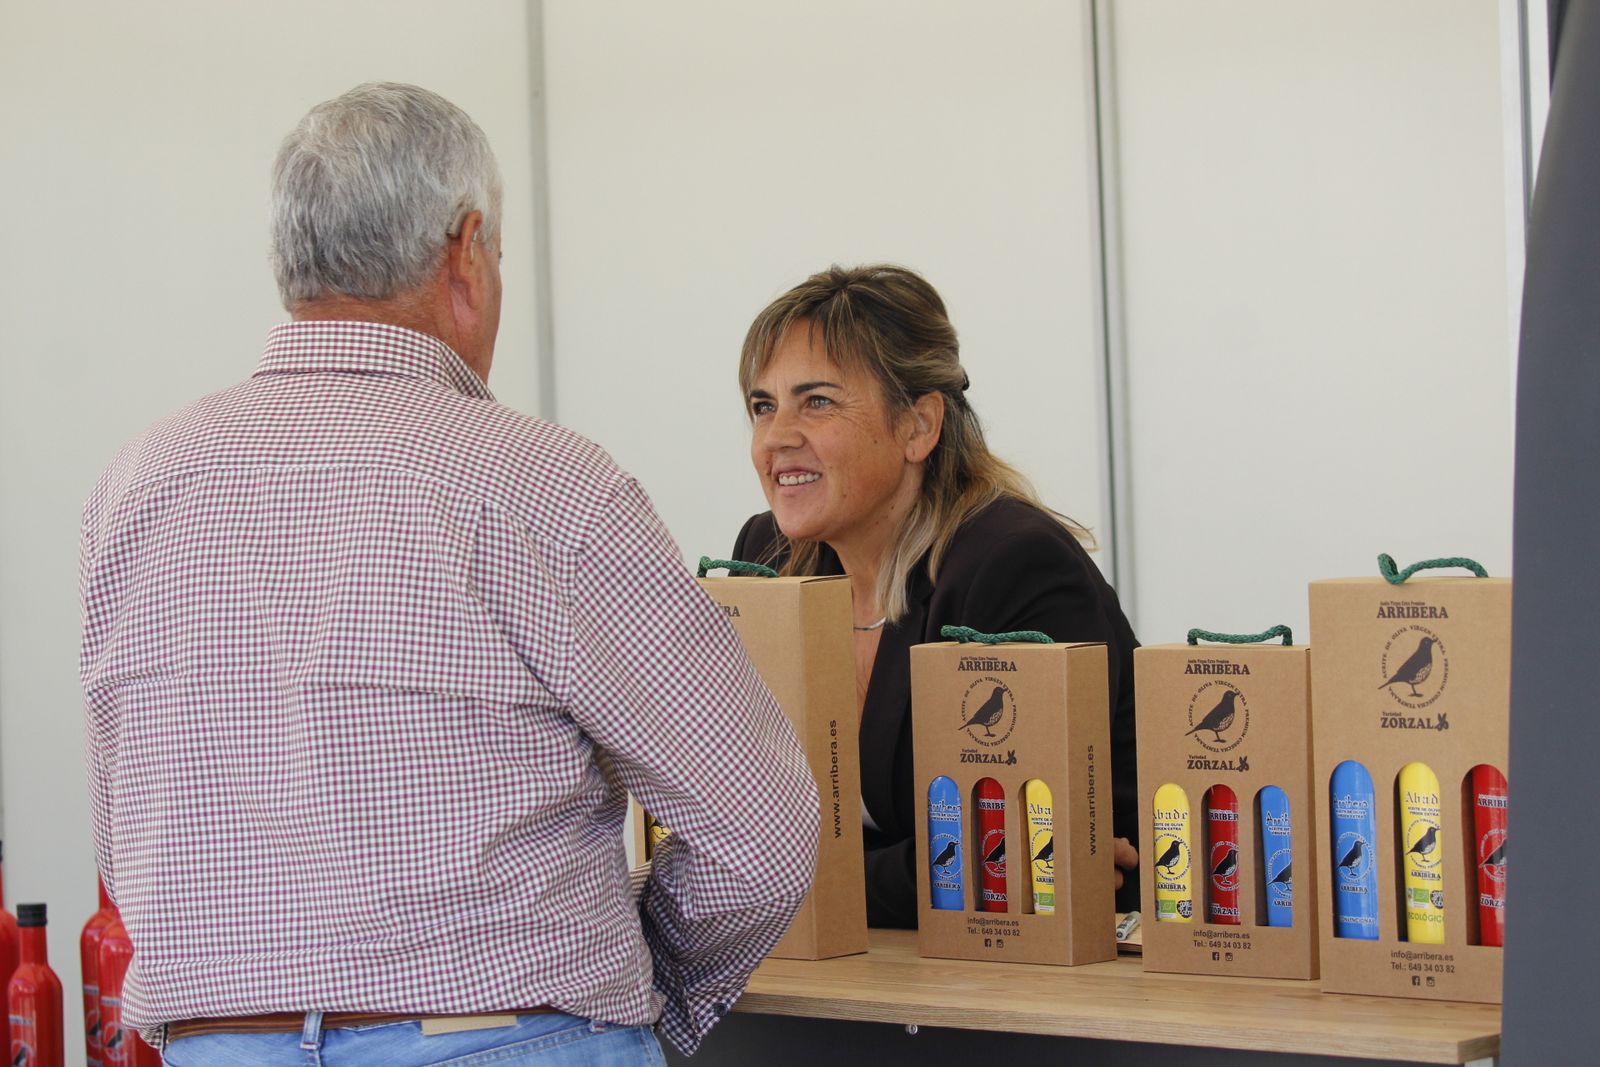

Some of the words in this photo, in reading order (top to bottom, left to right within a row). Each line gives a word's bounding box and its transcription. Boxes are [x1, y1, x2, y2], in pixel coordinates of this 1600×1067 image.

[1376, 606, 1448, 618] ARRIBERA
[1410, 625, 1432, 635] VIRGEN
[958, 661, 1017, 671] ARRIBERA
[1184, 664, 1250, 675] ARRIBERA
[985, 677, 1003, 685] VIRGEN
[1214, 680, 1234, 689] VIRGEN
[1380, 717, 1434, 729] ZORZAL
[960, 753, 1004, 763] ZORZAL
[1187, 760, 1235, 770] ZORZAL
[830, 720, 842, 839] www.arribera.es
[1087, 745, 1097, 856] www.arribera.es
[968, 917, 1019, 926] info@arribera.es
[968, 927, 980, 935] Tel.:
[1193, 929, 1250, 939] info@arribera.es
[1391, 950, 1454, 961] info@arribera.es
[1391, 961, 1406, 970] Tel.:
[1409, 963, 1421, 971] 649
[1424, 963, 1433, 971] 34
[1434, 964, 1444, 972] 03
[1446, 965, 1455, 973] 82
